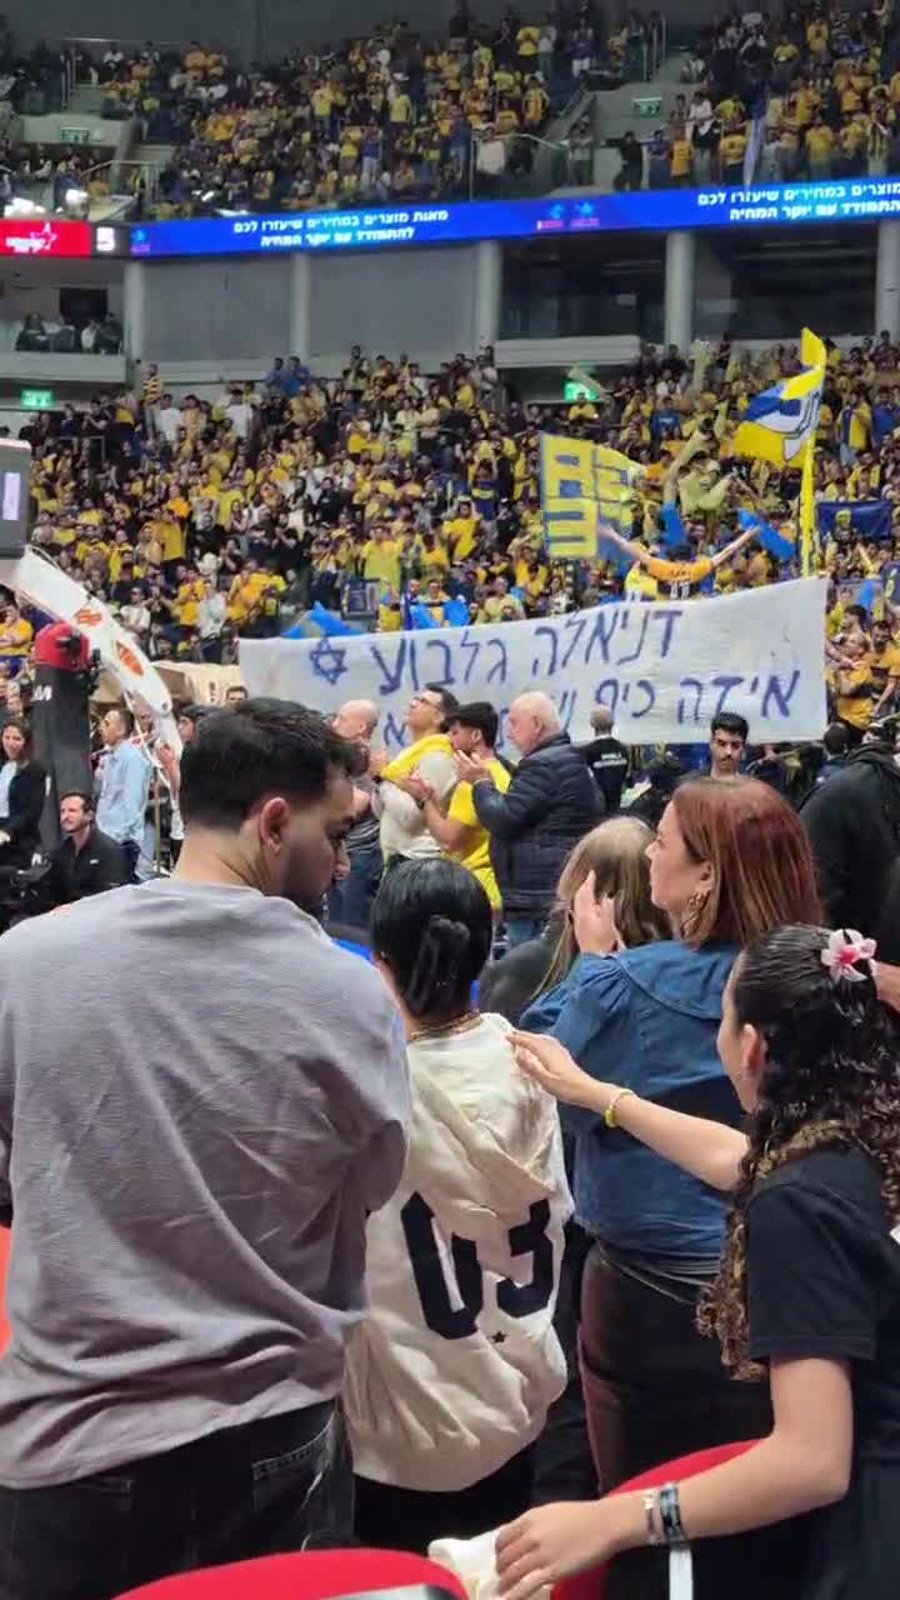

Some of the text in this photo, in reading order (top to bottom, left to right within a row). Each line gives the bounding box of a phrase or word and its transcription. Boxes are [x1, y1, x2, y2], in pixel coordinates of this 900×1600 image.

[698, 191, 726, 206] לכם
[369, 605, 683, 696] דניאלה גלבוע
